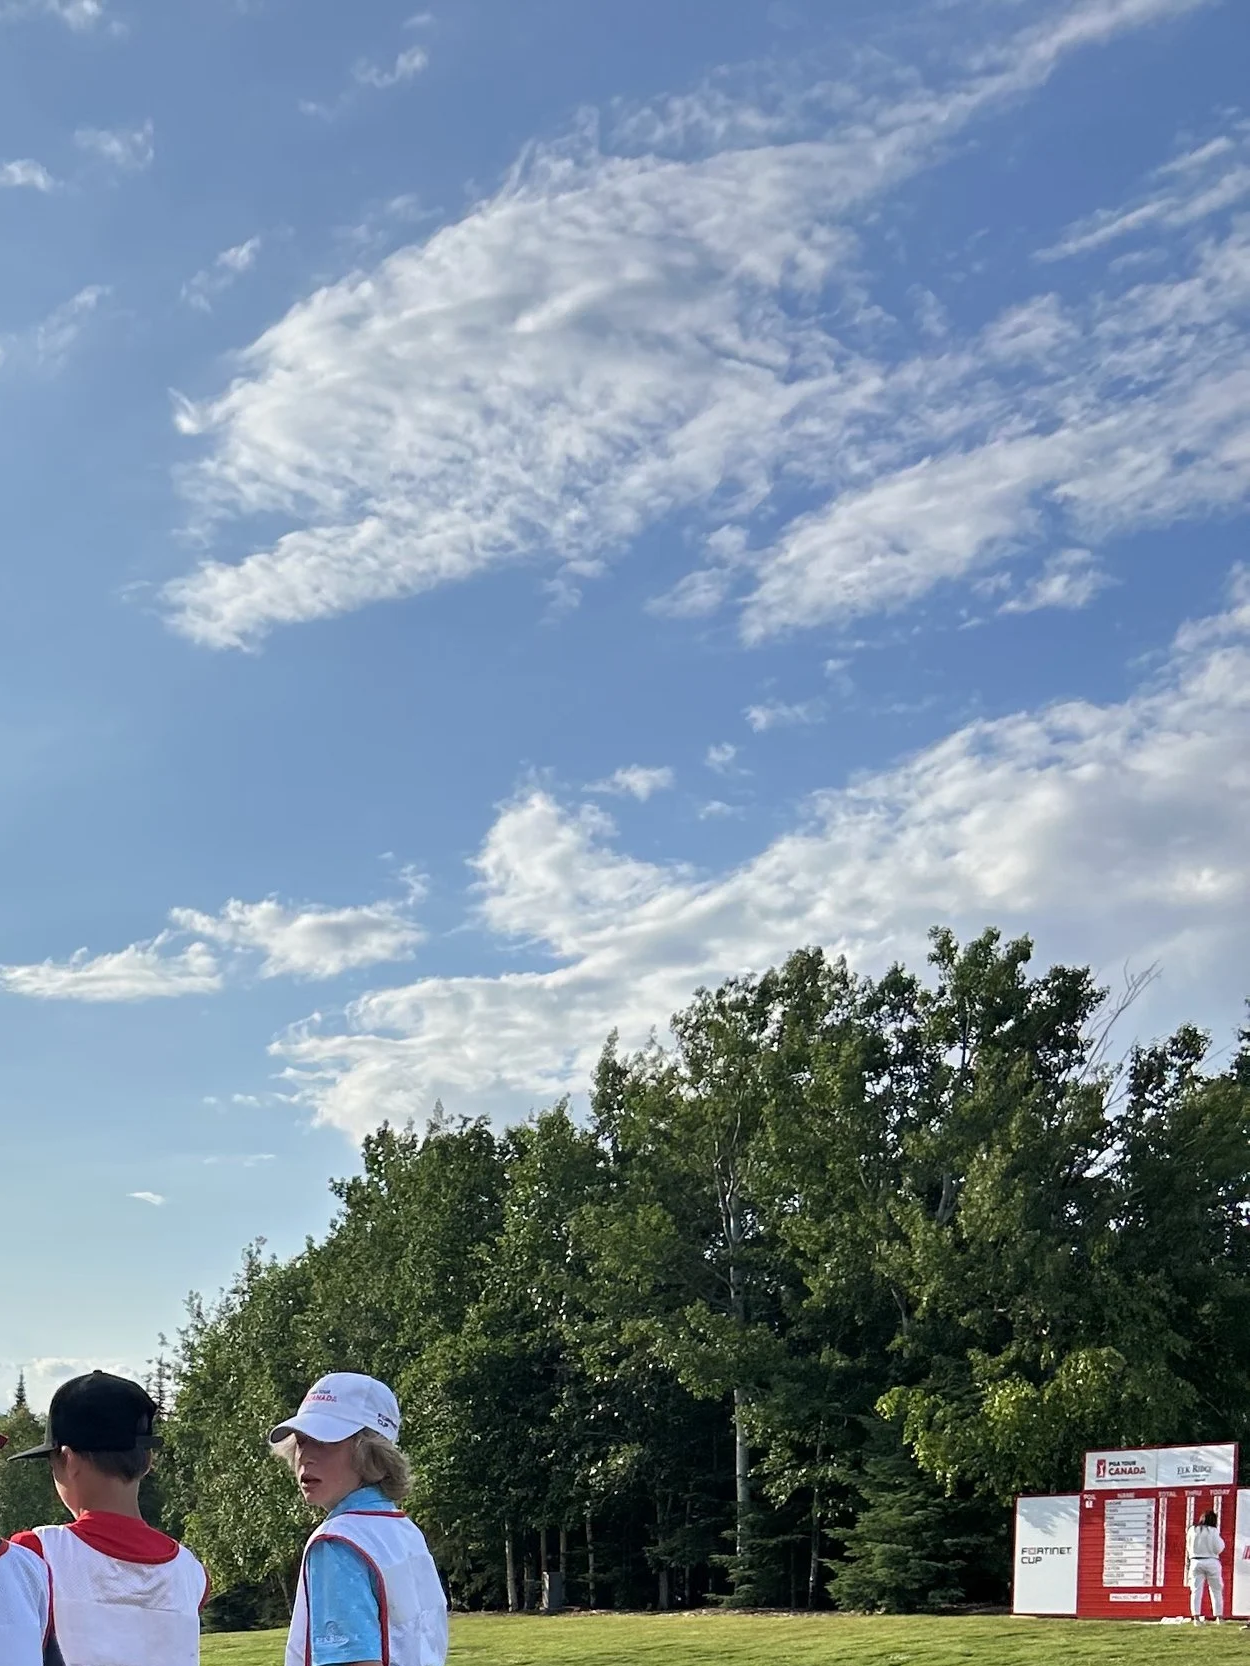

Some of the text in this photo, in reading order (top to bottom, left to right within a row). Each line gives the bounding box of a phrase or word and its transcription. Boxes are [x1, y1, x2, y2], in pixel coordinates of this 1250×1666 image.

[1108, 1466, 1146, 1476] CANADA
[1177, 1466, 1190, 1475] ELK
[1021, 1546, 1072, 1555] FORTINET
[1021, 1556, 1042, 1565] CUP
